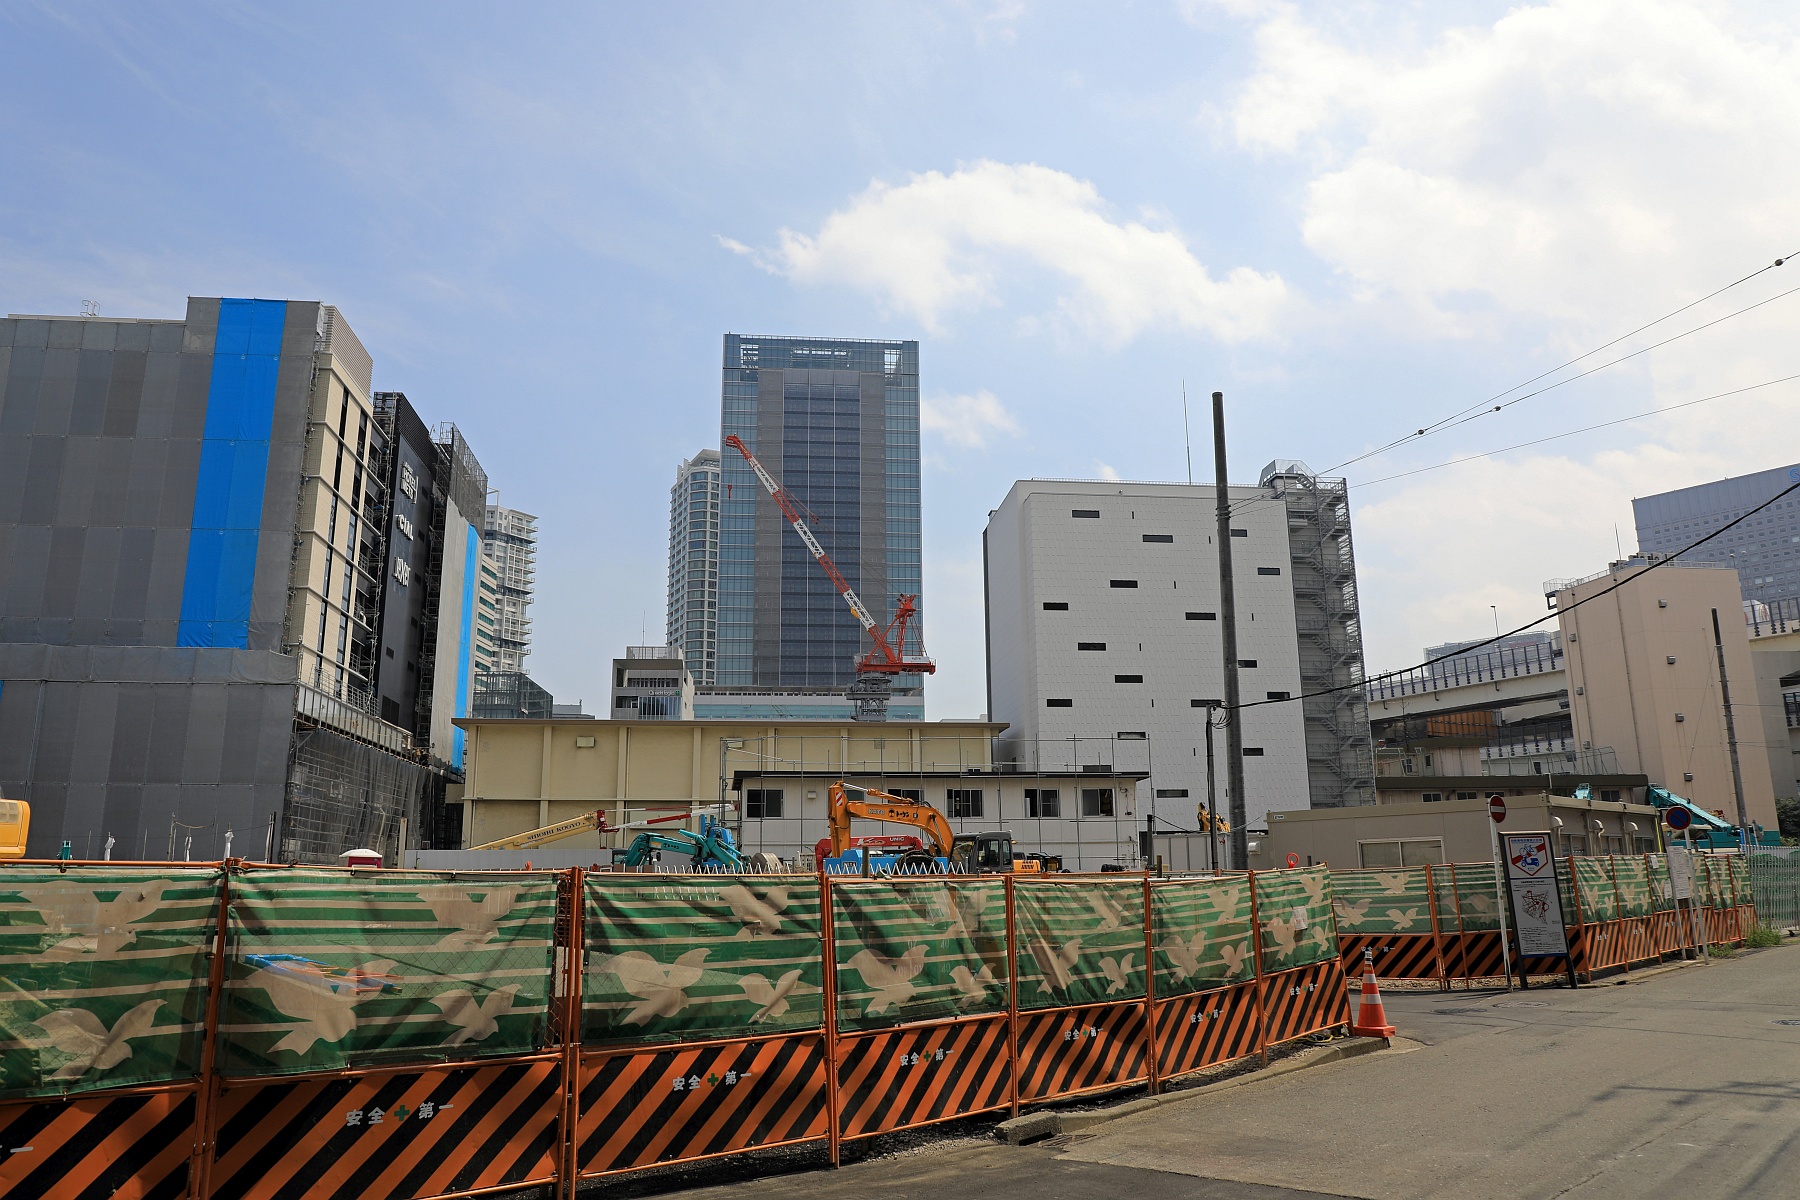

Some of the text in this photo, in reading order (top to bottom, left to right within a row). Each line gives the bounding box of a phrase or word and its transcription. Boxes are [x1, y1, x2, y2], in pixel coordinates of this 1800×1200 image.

[556, 821, 581, 833] KOGYO
[900, 1048, 955, 1066] 安全 第一
[672, 1070, 752, 1091] 安全 第一
[346, 1101, 454, 1126] 安全 第一
